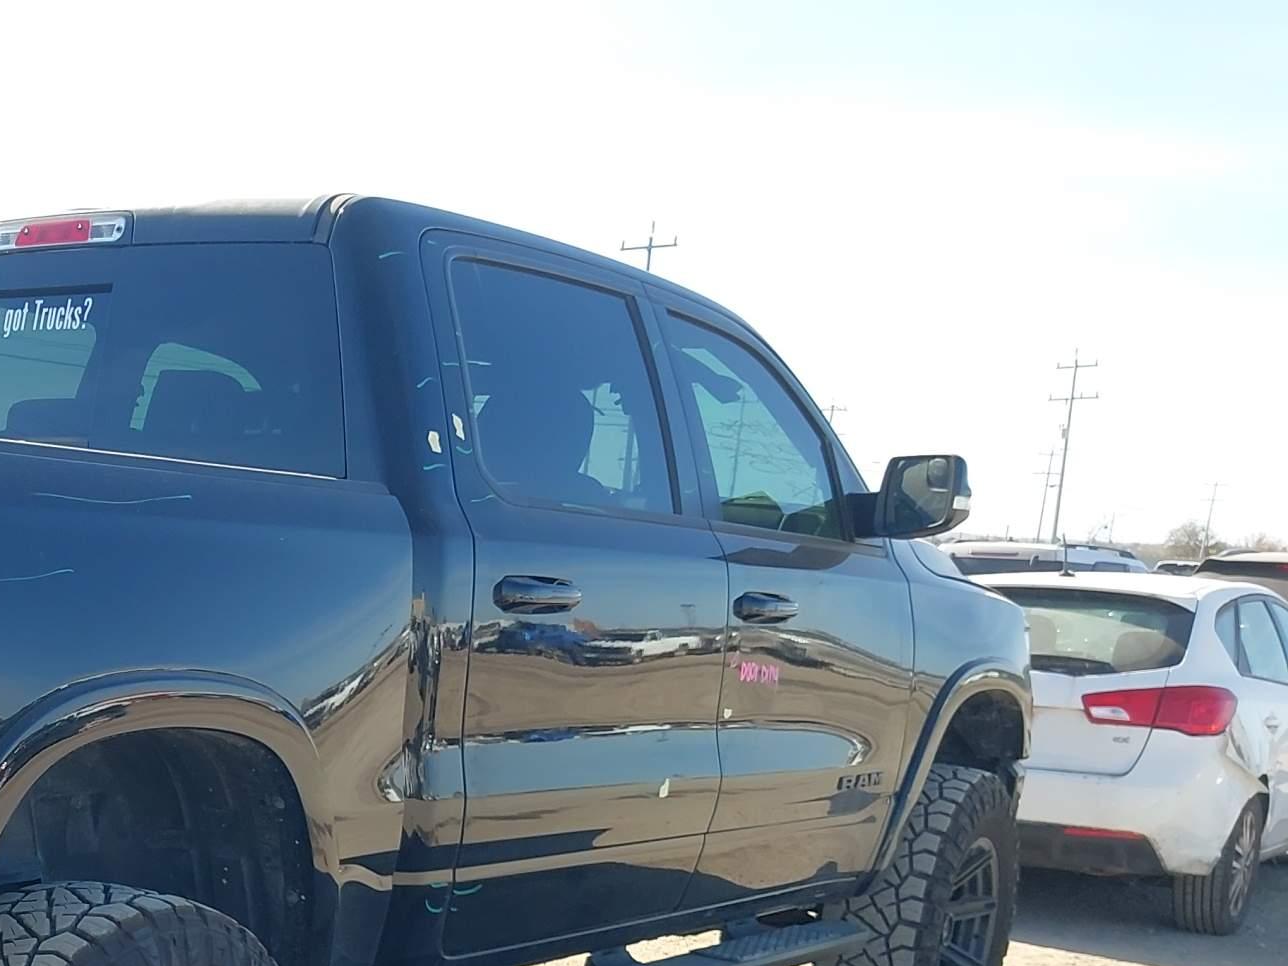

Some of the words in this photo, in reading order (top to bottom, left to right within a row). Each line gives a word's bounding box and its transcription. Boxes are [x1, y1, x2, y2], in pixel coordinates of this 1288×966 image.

[3, 301, 29, 338] got
[32, 297, 93, 331] Trucks?
[837, 771, 883, 791] RAM
